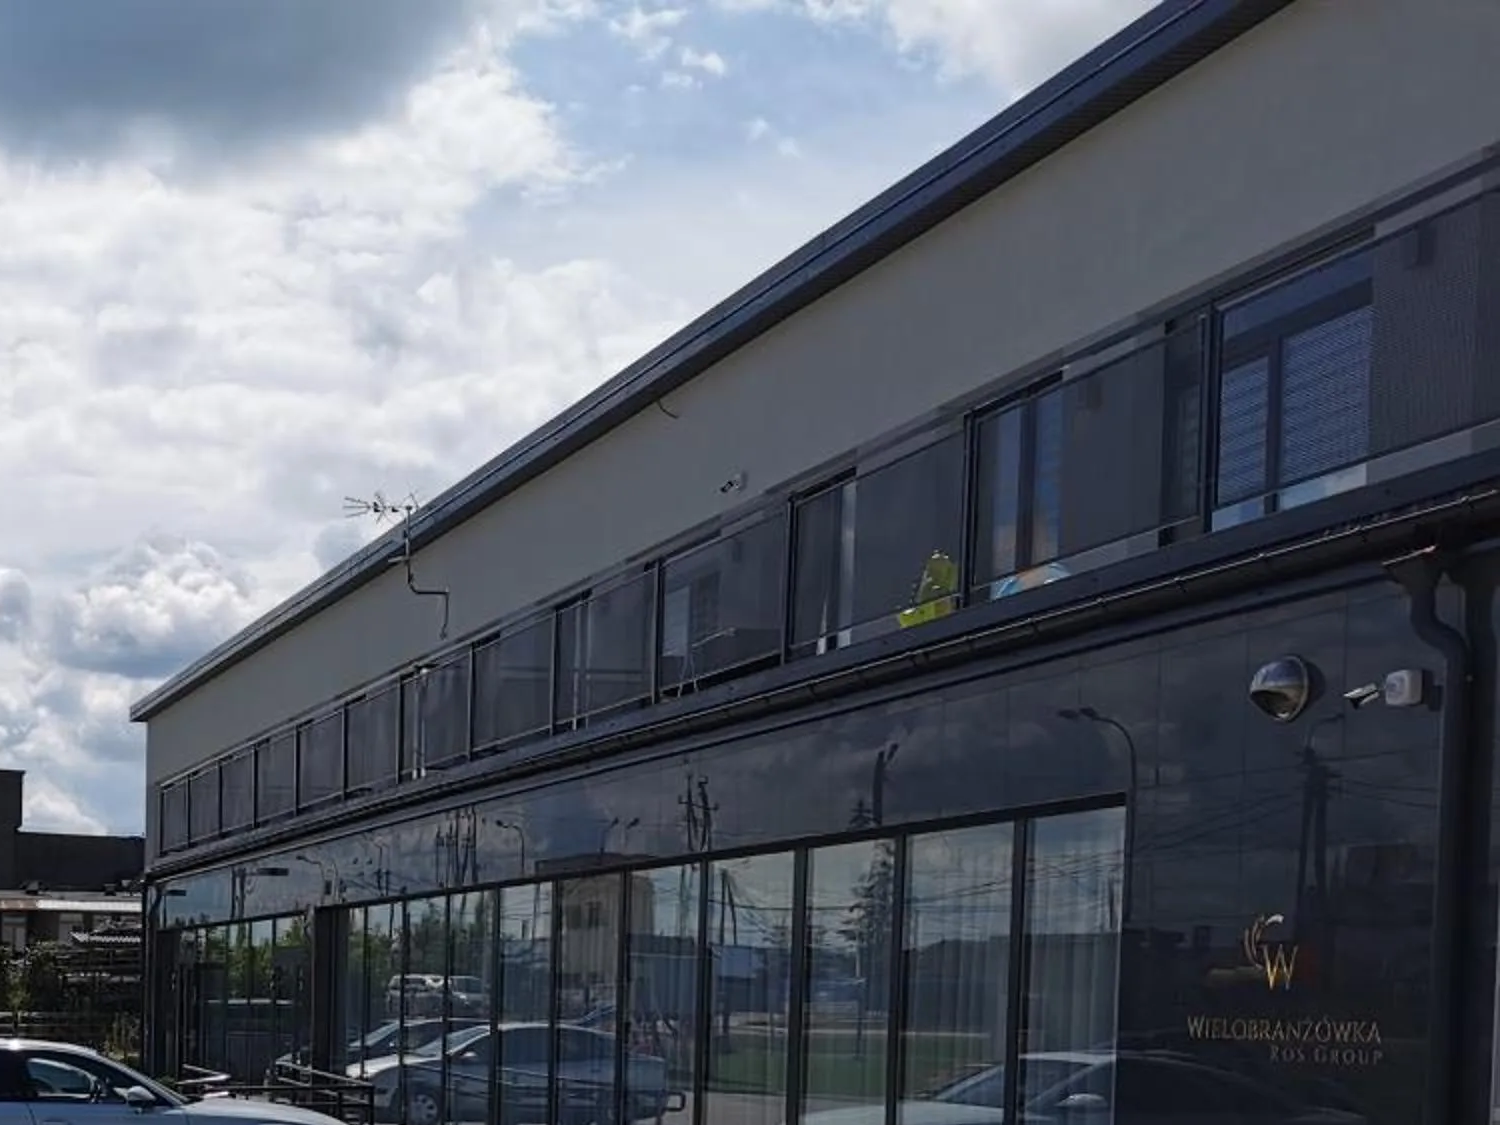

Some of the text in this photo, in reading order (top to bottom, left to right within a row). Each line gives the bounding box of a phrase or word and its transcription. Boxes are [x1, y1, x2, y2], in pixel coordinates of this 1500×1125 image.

[1262, 944, 1299, 991] W
[1269, 1045, 1383, 1066] ROS GROUP
